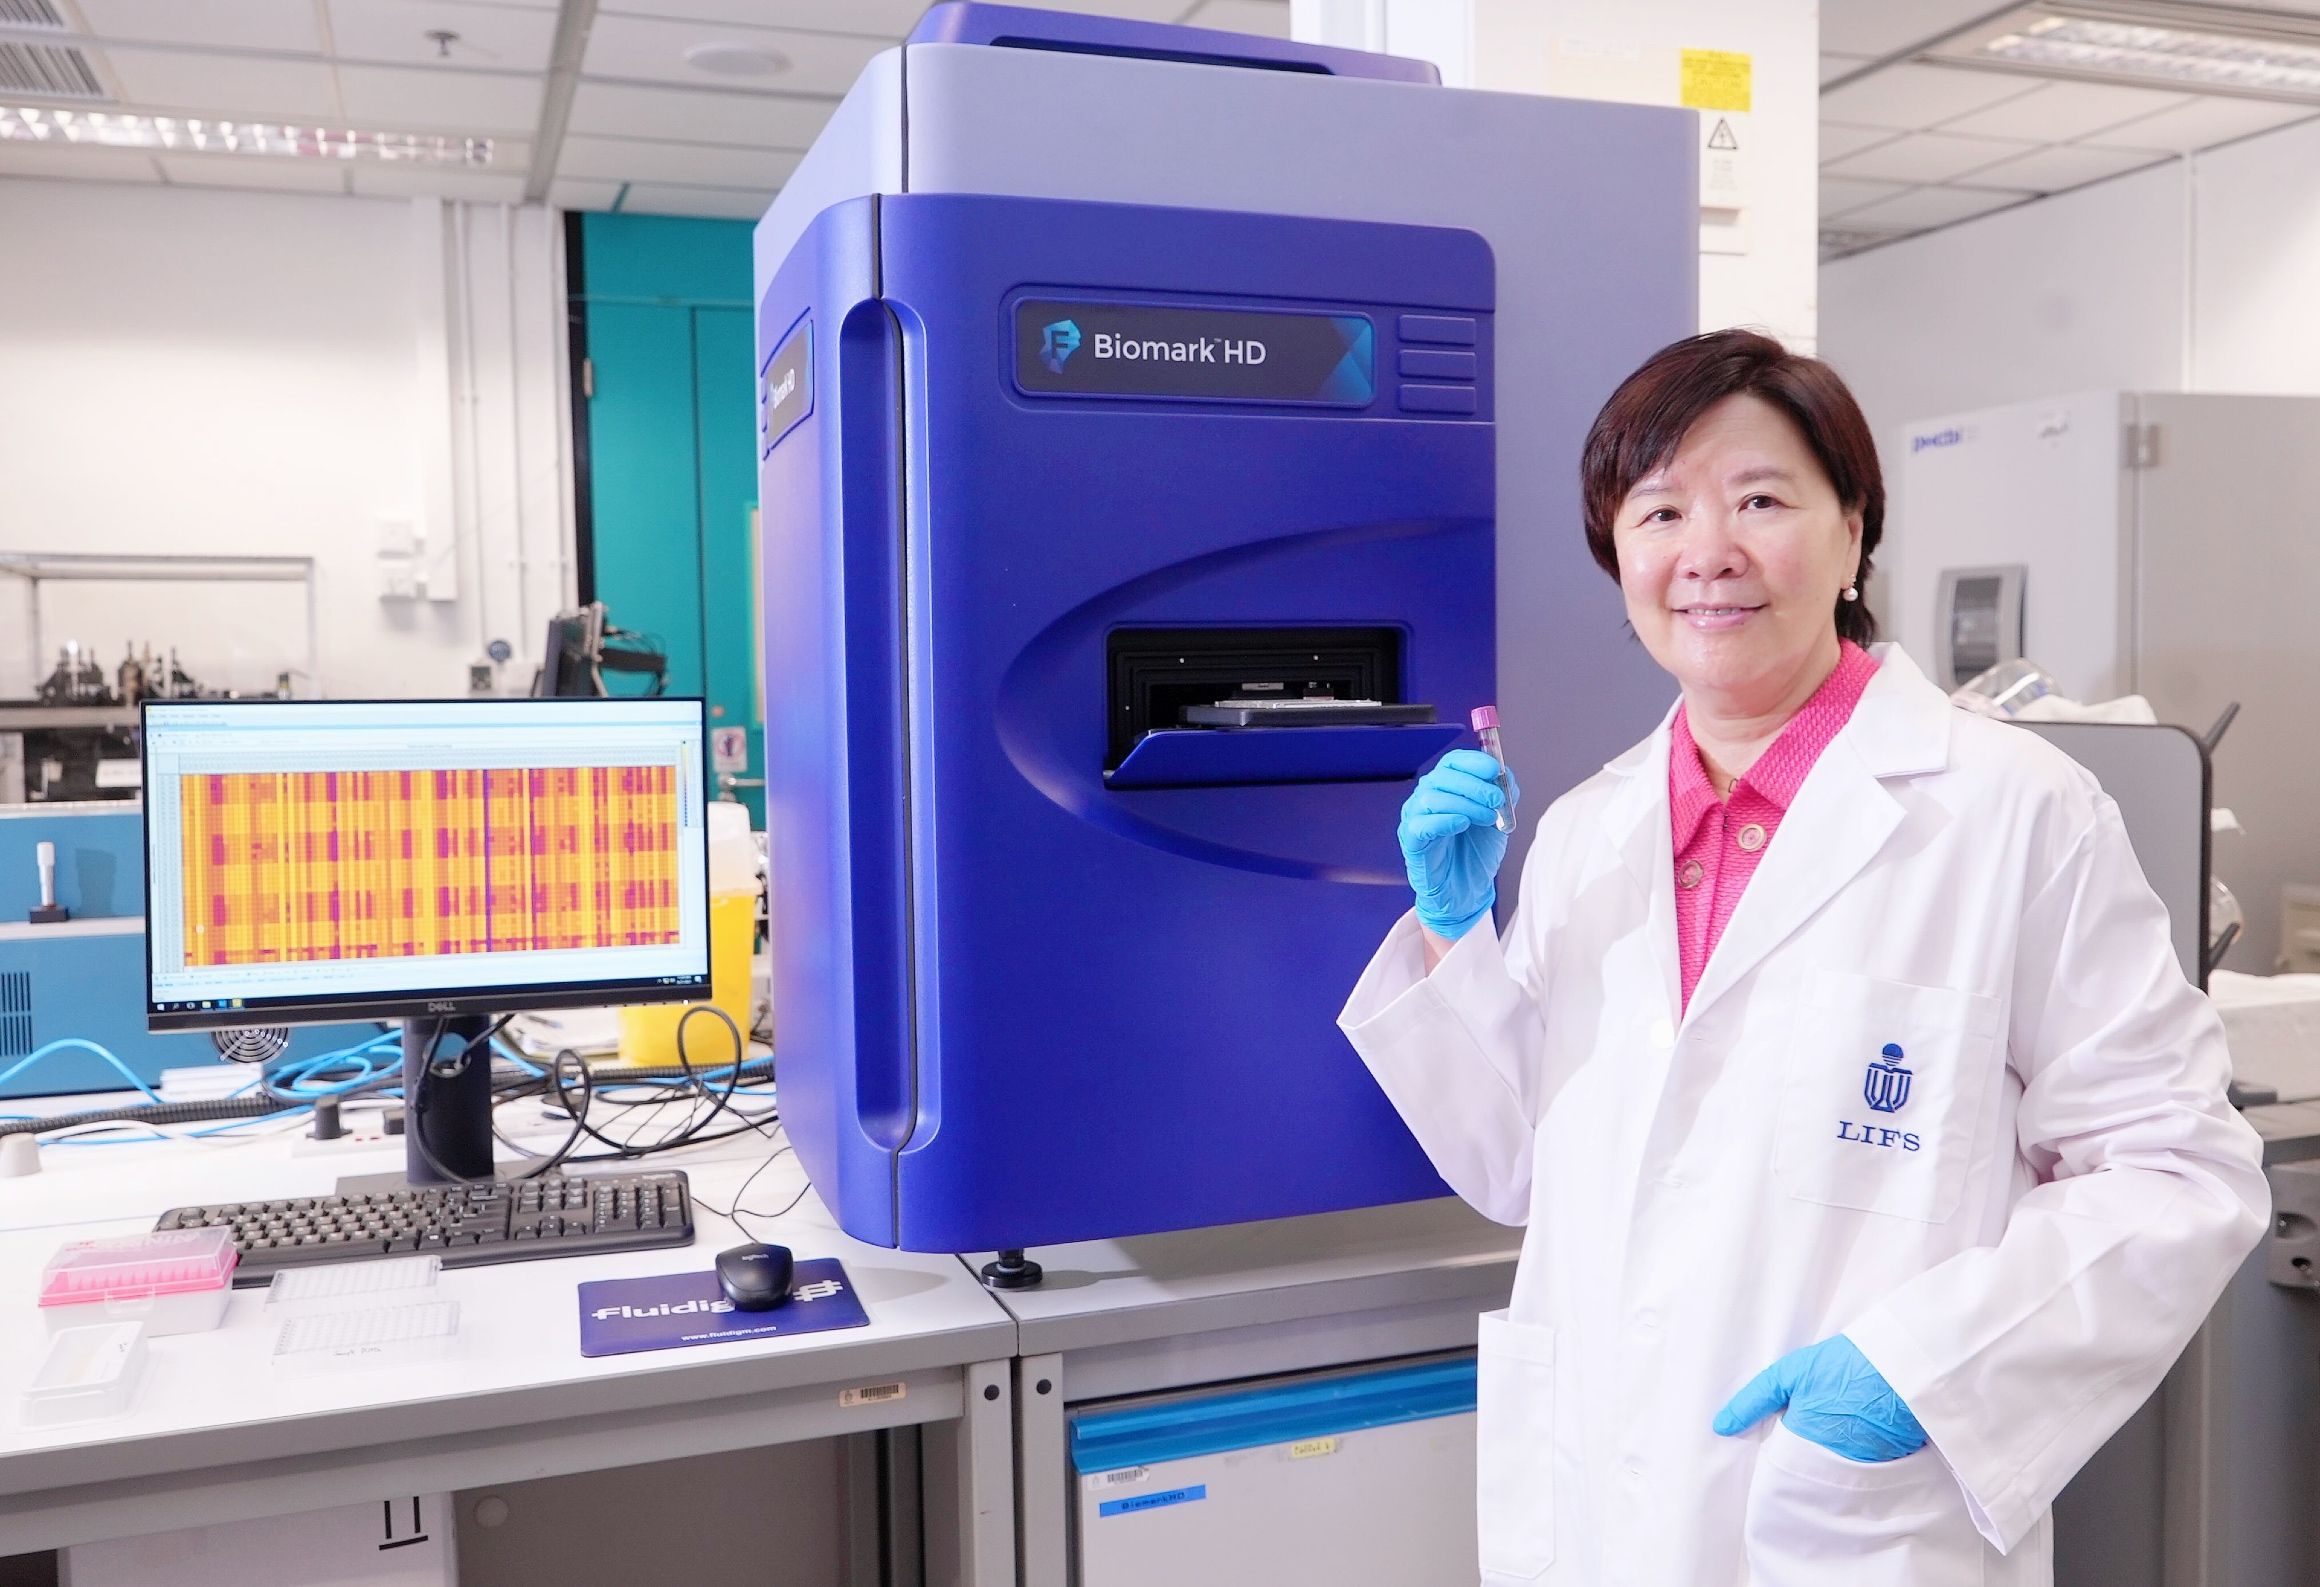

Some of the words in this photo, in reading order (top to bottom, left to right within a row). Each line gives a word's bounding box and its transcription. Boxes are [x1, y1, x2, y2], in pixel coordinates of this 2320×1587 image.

[1224, 340, 1267, 365] HD
[428, 1001, 457, 1012] DELL
[1837, 1120, 1920, 1151] LIFS
[591, 1300, 735, 1320] fluidig
[681, 1325, 777, 1341] www.fluidigm.com
